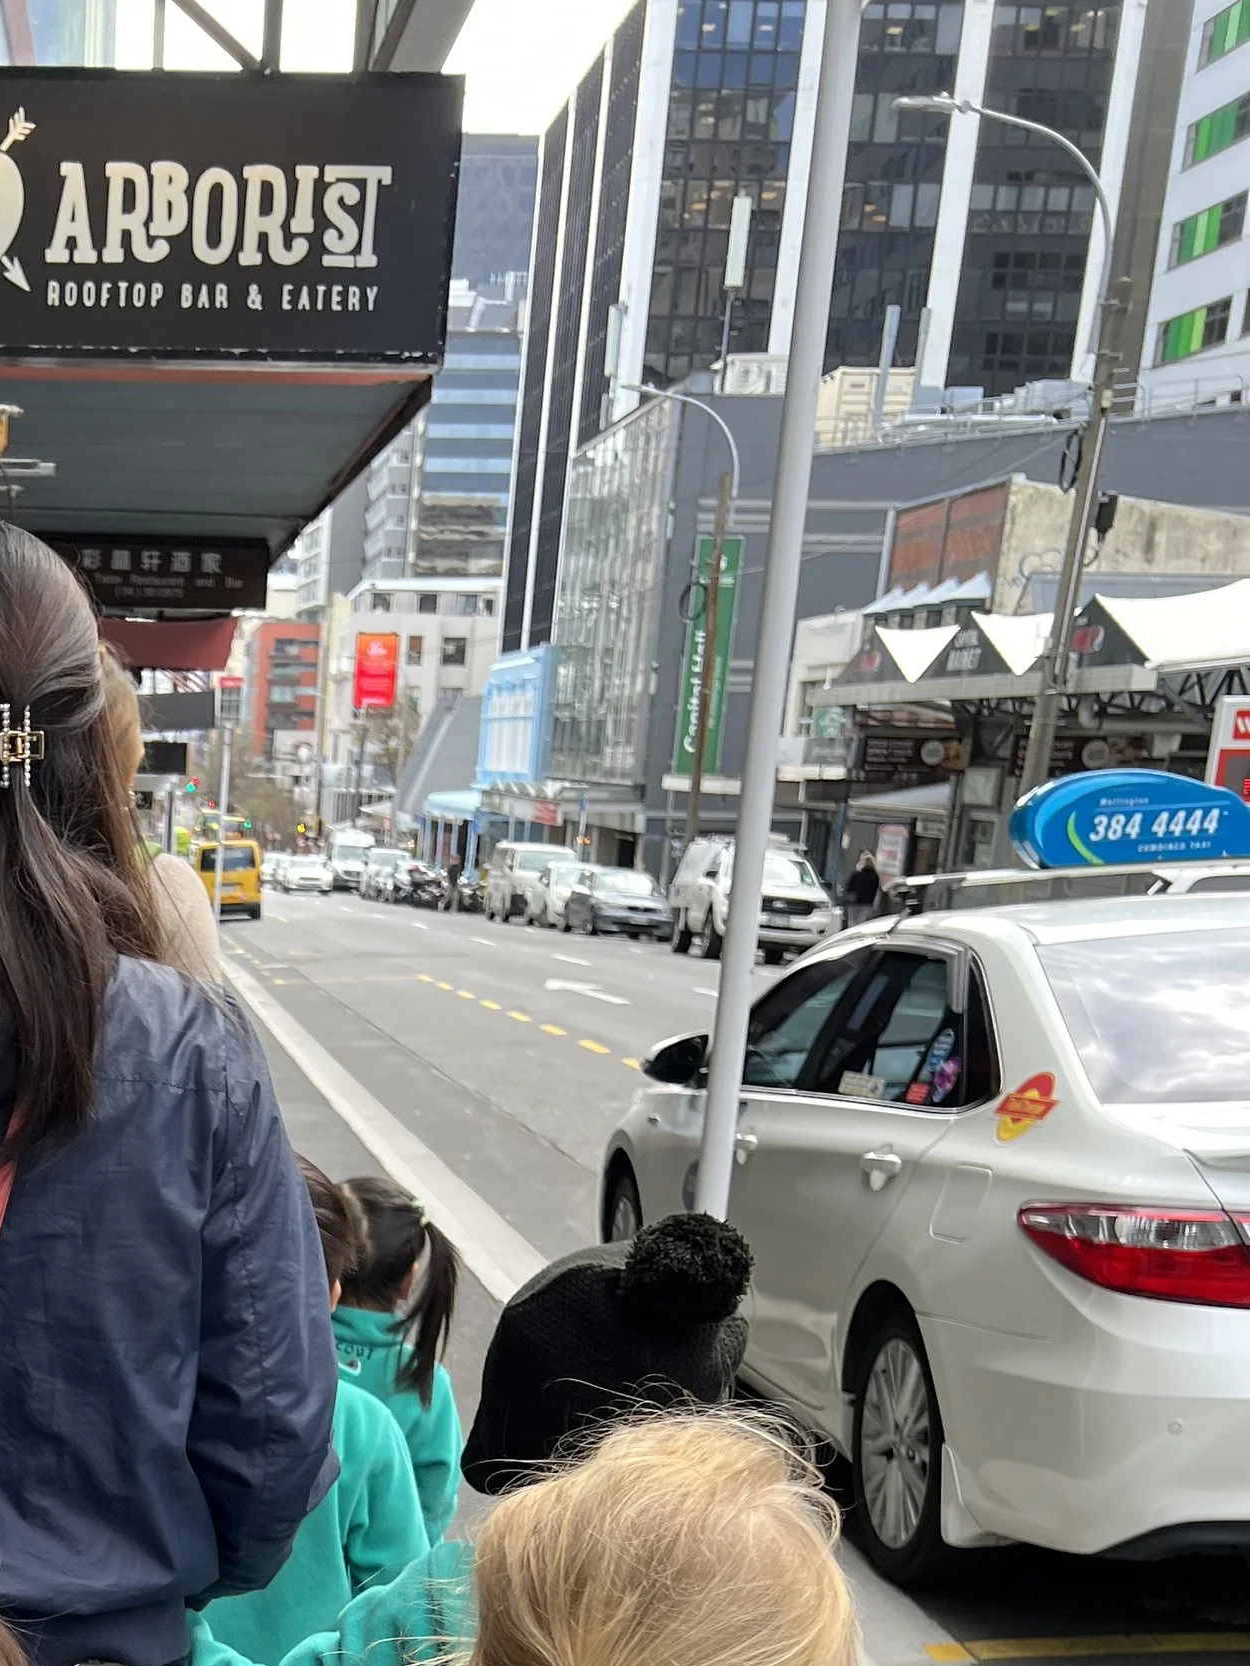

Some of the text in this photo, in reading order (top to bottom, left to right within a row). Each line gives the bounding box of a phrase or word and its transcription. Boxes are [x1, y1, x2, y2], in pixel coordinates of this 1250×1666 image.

[45, 160, 393, 267] ARBORIST
[46, 279, 379, 311] ROOFTOP BAR & EATERY
[1088, 807, 1221, 843] 384 4444
